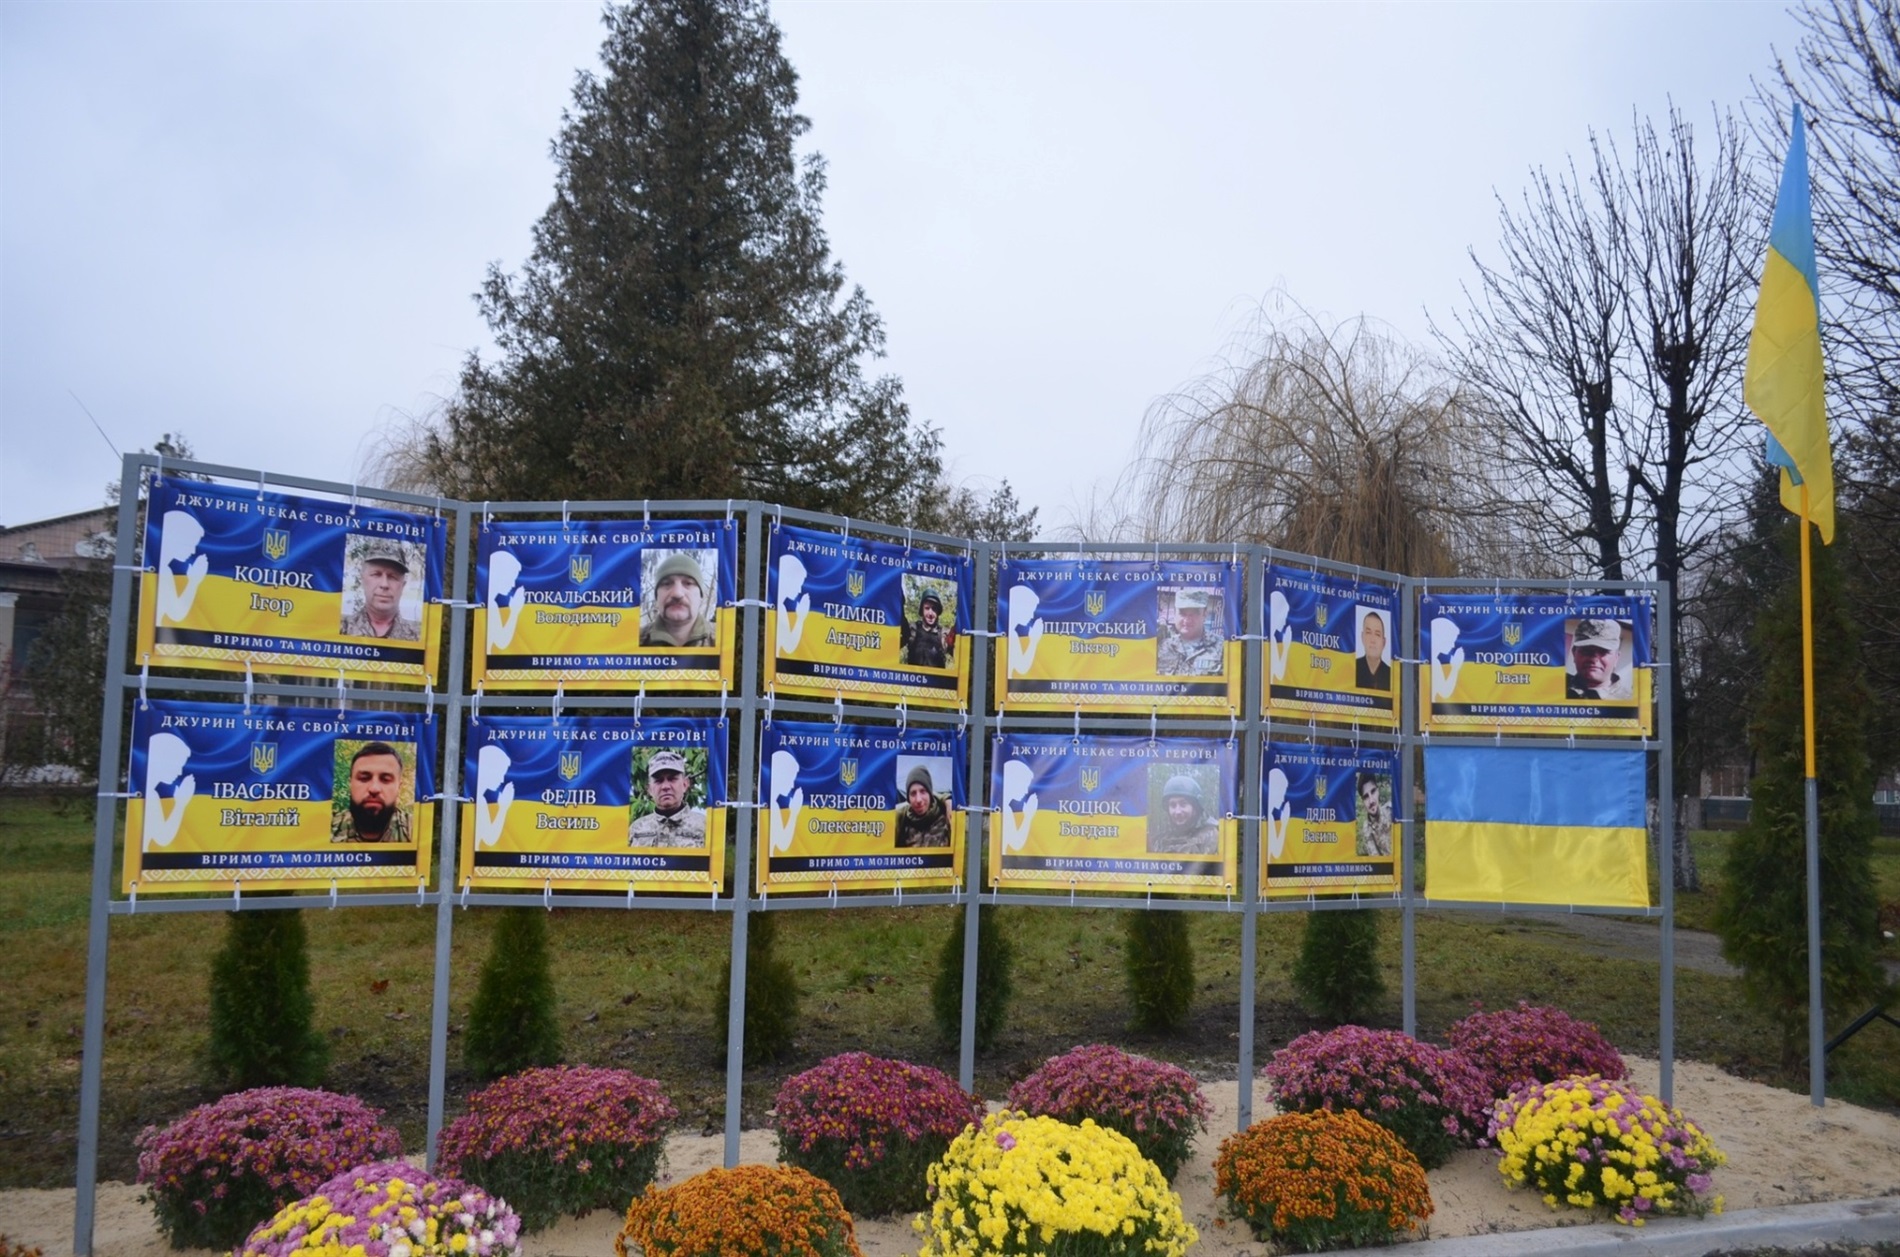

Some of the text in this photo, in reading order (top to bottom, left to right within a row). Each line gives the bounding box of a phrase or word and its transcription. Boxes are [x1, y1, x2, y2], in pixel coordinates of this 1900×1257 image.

[176, 493, 425, 538] ДЖУРИН ЧЕКАЄ СВОЇХ ГЕРОЇВ!
[498, 532, 716, 546] ДЖУРИН ЧЕКАЄ СВОЇХ ГЕРОЇВ!
[788, 540, 957, 576] ДЖУРИН ЧЕКАЄ СВОЇХ ГЕРОЇВ!
[234, 565, 313, 590] КОЦЮК
[1017, 572, 1222, 582] ДЖУРИН ЧЕКАЄ СВОЇХ ГЕРОЇВ!
[525, 587, 634, 604] ТОКАЛЬСЬКИЙ
[1275, 578, 1390, 606] ДЖУРИН ЧЕКАЄ СВОЇХ ГЕРОЇВ!
[250, 594, 293, 616] Ігор
[824, 602, 885, 624] ТИМКІВ
[1438, 606, 1630, 615] ДЖУРИН ЧЕКАЄ СВОЇХ ГЕРОЇВ!
[536, 611, 621, 626] Володимир
[1043, 620, 1147, 636] ПІДГУРСЬКИЙ
[214, 634, 380, 657] ВІРИМО ТА МОЛИМОСЬ
[826, 628, 881, 650] Андрій
[1302, 631, 1340, 650] КОЦЮК
[1070, 641, 1119, 656] Віктор
[532, 657, 677, 666] ВІРИМО ТА МОЛИМОСЬ
[1310, 654, 1331, 672] Ігор
[1475, 652, 1550, 665] ГОРОШКО
[814, 664, 928, 683] ВІРИМО ТА МОЛИМОСЬ
[1495, 671, 1530, 684] Іван
[1051, 682, 1187, 692] ВІРИМО ТА МОЛИМОСЬ
[1296, 689, 1323, 699] ВІРИМО
[1336, 694, 1374, 704] МОЛИМОСЬ
[1471, 705, 1600, 715] ВІРИМО ТА МОЛИМОСЬ
[161, 716, 415, 736] ДЖУРИН ЧЕКАЄ СВОЇХ ГЕРОЇВ!
[488, 730, 706, 742] ДЖУРИН ЧЕКАЄ СВОЇХ ГЕРОЇВ!
[779, 735, 951, 751] ДЖУРИН ЧЕКАЄ СВОЇХ ГЕРОЇВ!
[1012, 746, 1217, 759] ДЖУРИН ЧЕКАЄ СВОЇХ ГЕРОЇВ!
[1275, 754, 1390, 769] ДЖУРИН ЧЕКАЄ СВОЇХ ГЕРОЇВ!
[212, 783, 310, 800] ІВАСЬКІВ
[541, 788, 596, 806] ФЕДІВ
[1058, 800, 1121, 816] КОЦЮК
[220, 809, 300, 827] Віталій
[536, 813, 599, 830] Василь
[1305, 808, 1336, 825] ДЯДІВ
[809, 819, 885, 836] Олександр
[1059, 821, 1119, 838] Богдан
[1303, 829, 1338, 843] Василь
[202, 853, 372, 865] ВІРИМО ТА МОЛИМОСЬ
[520, 855, 667, 867] ВІРИМО ТА МОЛИМОСЬ
[809, 857, 924, 868] ВІРИМО ТА МОЛИМОСЬ
[1045, 859, 1183, 871] ВІРИМО ТА МОЛИМОСЬ
[1294, 865, 1322, 873] ВІРИМО
[1335, 864, 1373, 872] МОЛИМОСЬ
